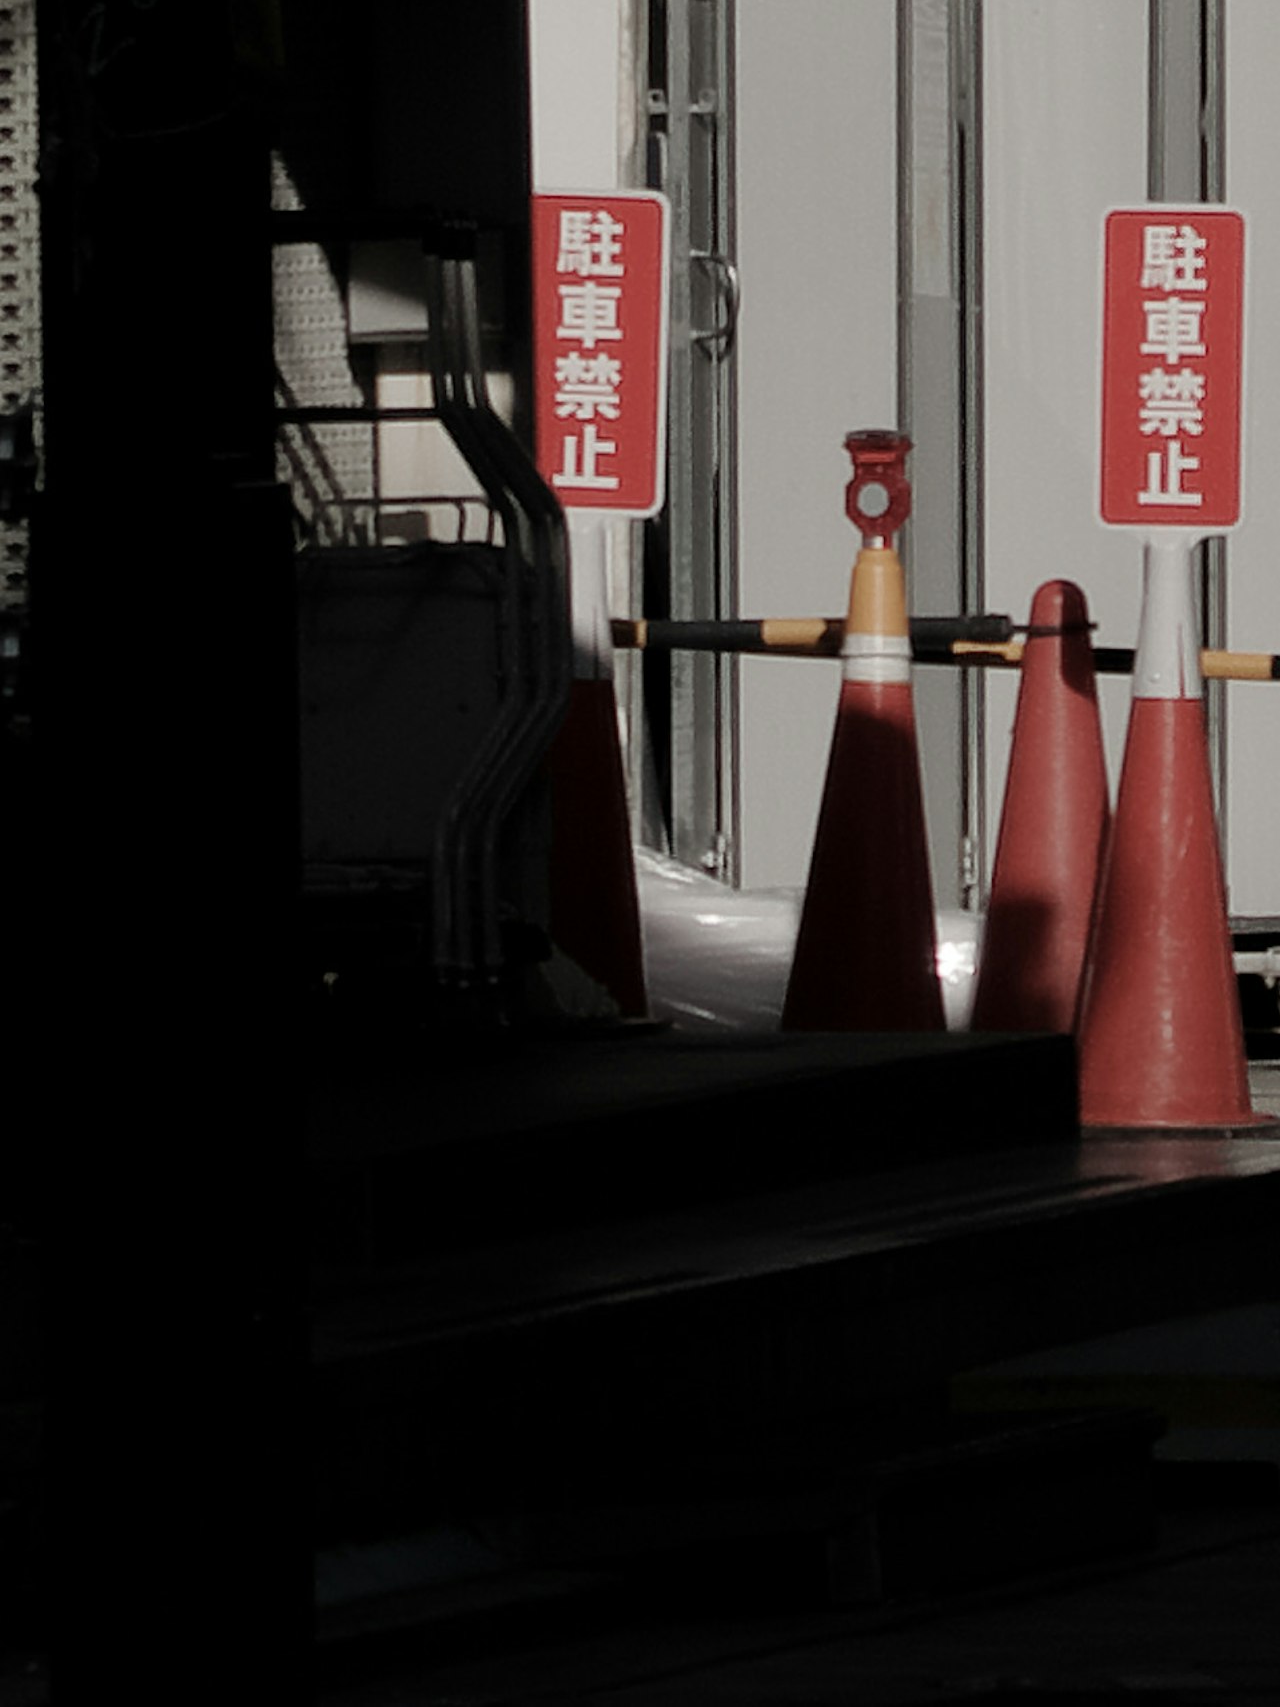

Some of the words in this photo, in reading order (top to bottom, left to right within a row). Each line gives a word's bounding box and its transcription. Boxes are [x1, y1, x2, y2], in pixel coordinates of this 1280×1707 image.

[552, 209, 625, 492] 駐車禁止
[1136, 224, 1210, 507] 駐車禁止
